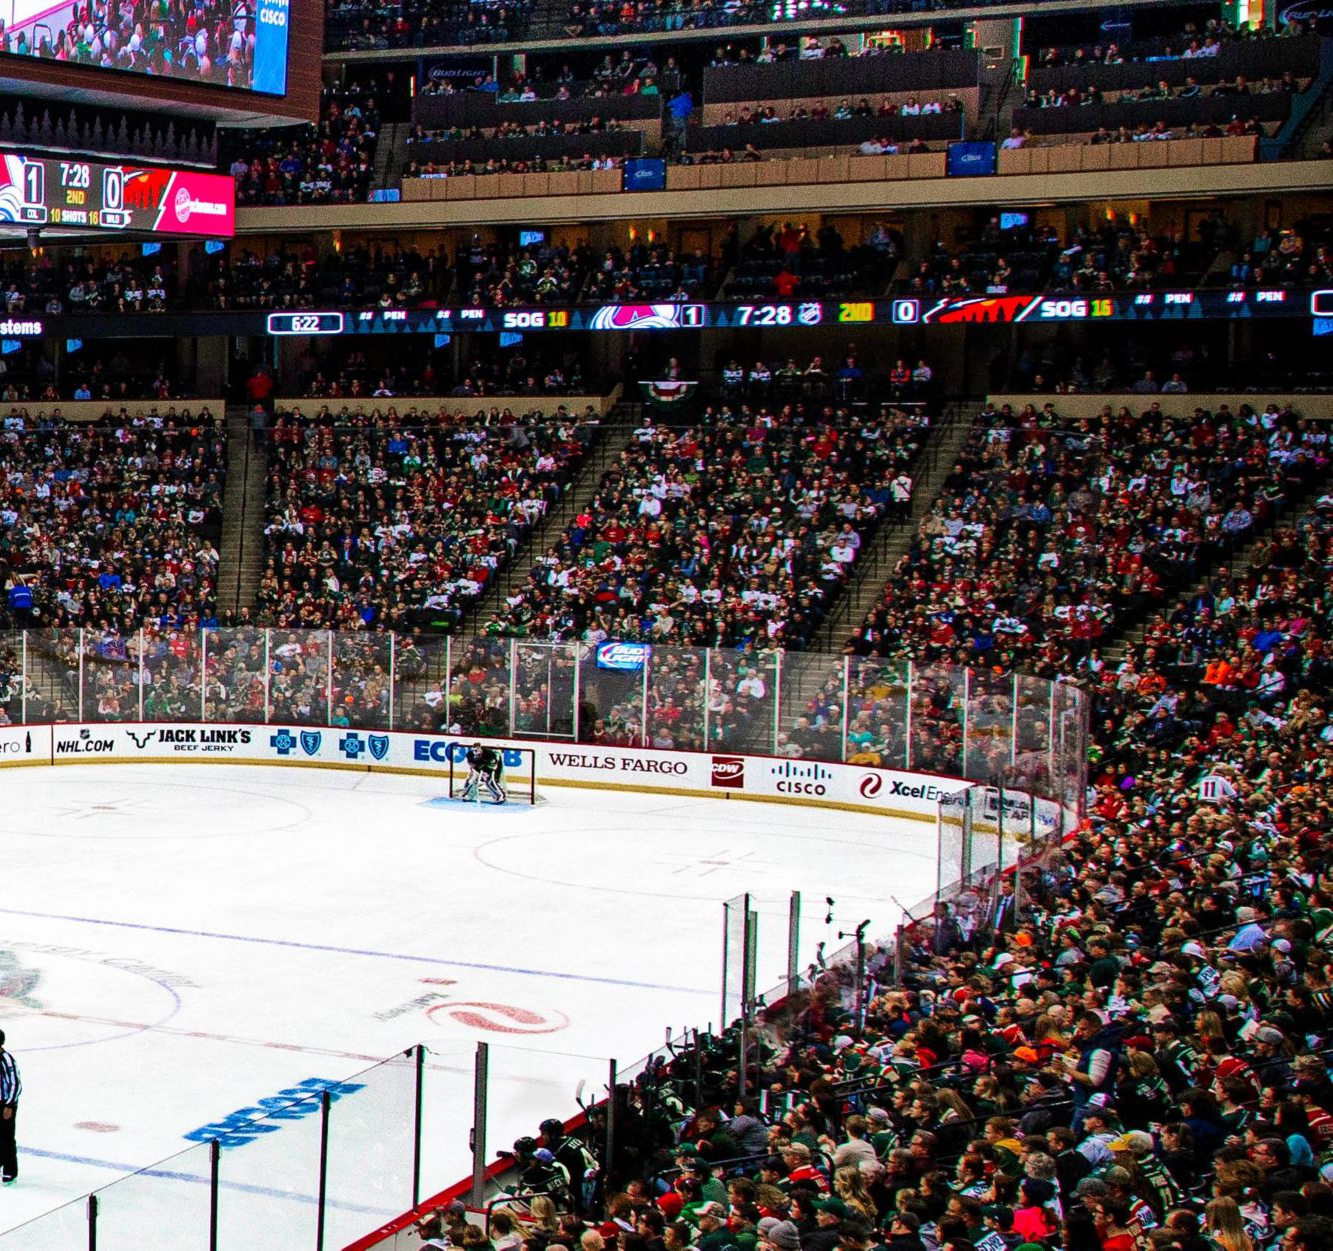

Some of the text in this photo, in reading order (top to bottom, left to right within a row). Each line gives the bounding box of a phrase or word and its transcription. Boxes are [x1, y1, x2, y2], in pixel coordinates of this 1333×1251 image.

[259, 9, 285, 26] CISCO
[60, 163, 90, 188] 7:28
[27, 166, 38, 203] 1
[107, 173, 119, 207] 0
[66, 189, 85, 205] 2ND
[50, 208, 99, 226] 10 SHOTS 16
[1165, 293, 1193, 304] PEN
[1257, 291, 1284, 302] PEN
[384, 310, 406, 320] PEN
[461, 309, 484, 319] PEN
[686, 307, 698, 324] 1
[739, 306, 793, 325] 7:28
[839, 303, 873, 322] 2ND
[898, 303, 914, 321] 0
[1041, 300, 1112, 317] SOG 16
[291, 316, 319, 332] 6:22
[504, 312, 544, 328] SOG
[159, 728, 252, 743] JACK LINK'S
[56, 740, 114, 753] NHL.COM
[414, 740, 522, 767] ECOB
[549, 753, 688, 775] WELLS FARGO
[712, 763, 739, 774] CDW
[776, 780, 826, 796] CISCO
[889, 781, 926, 799] Xcel
